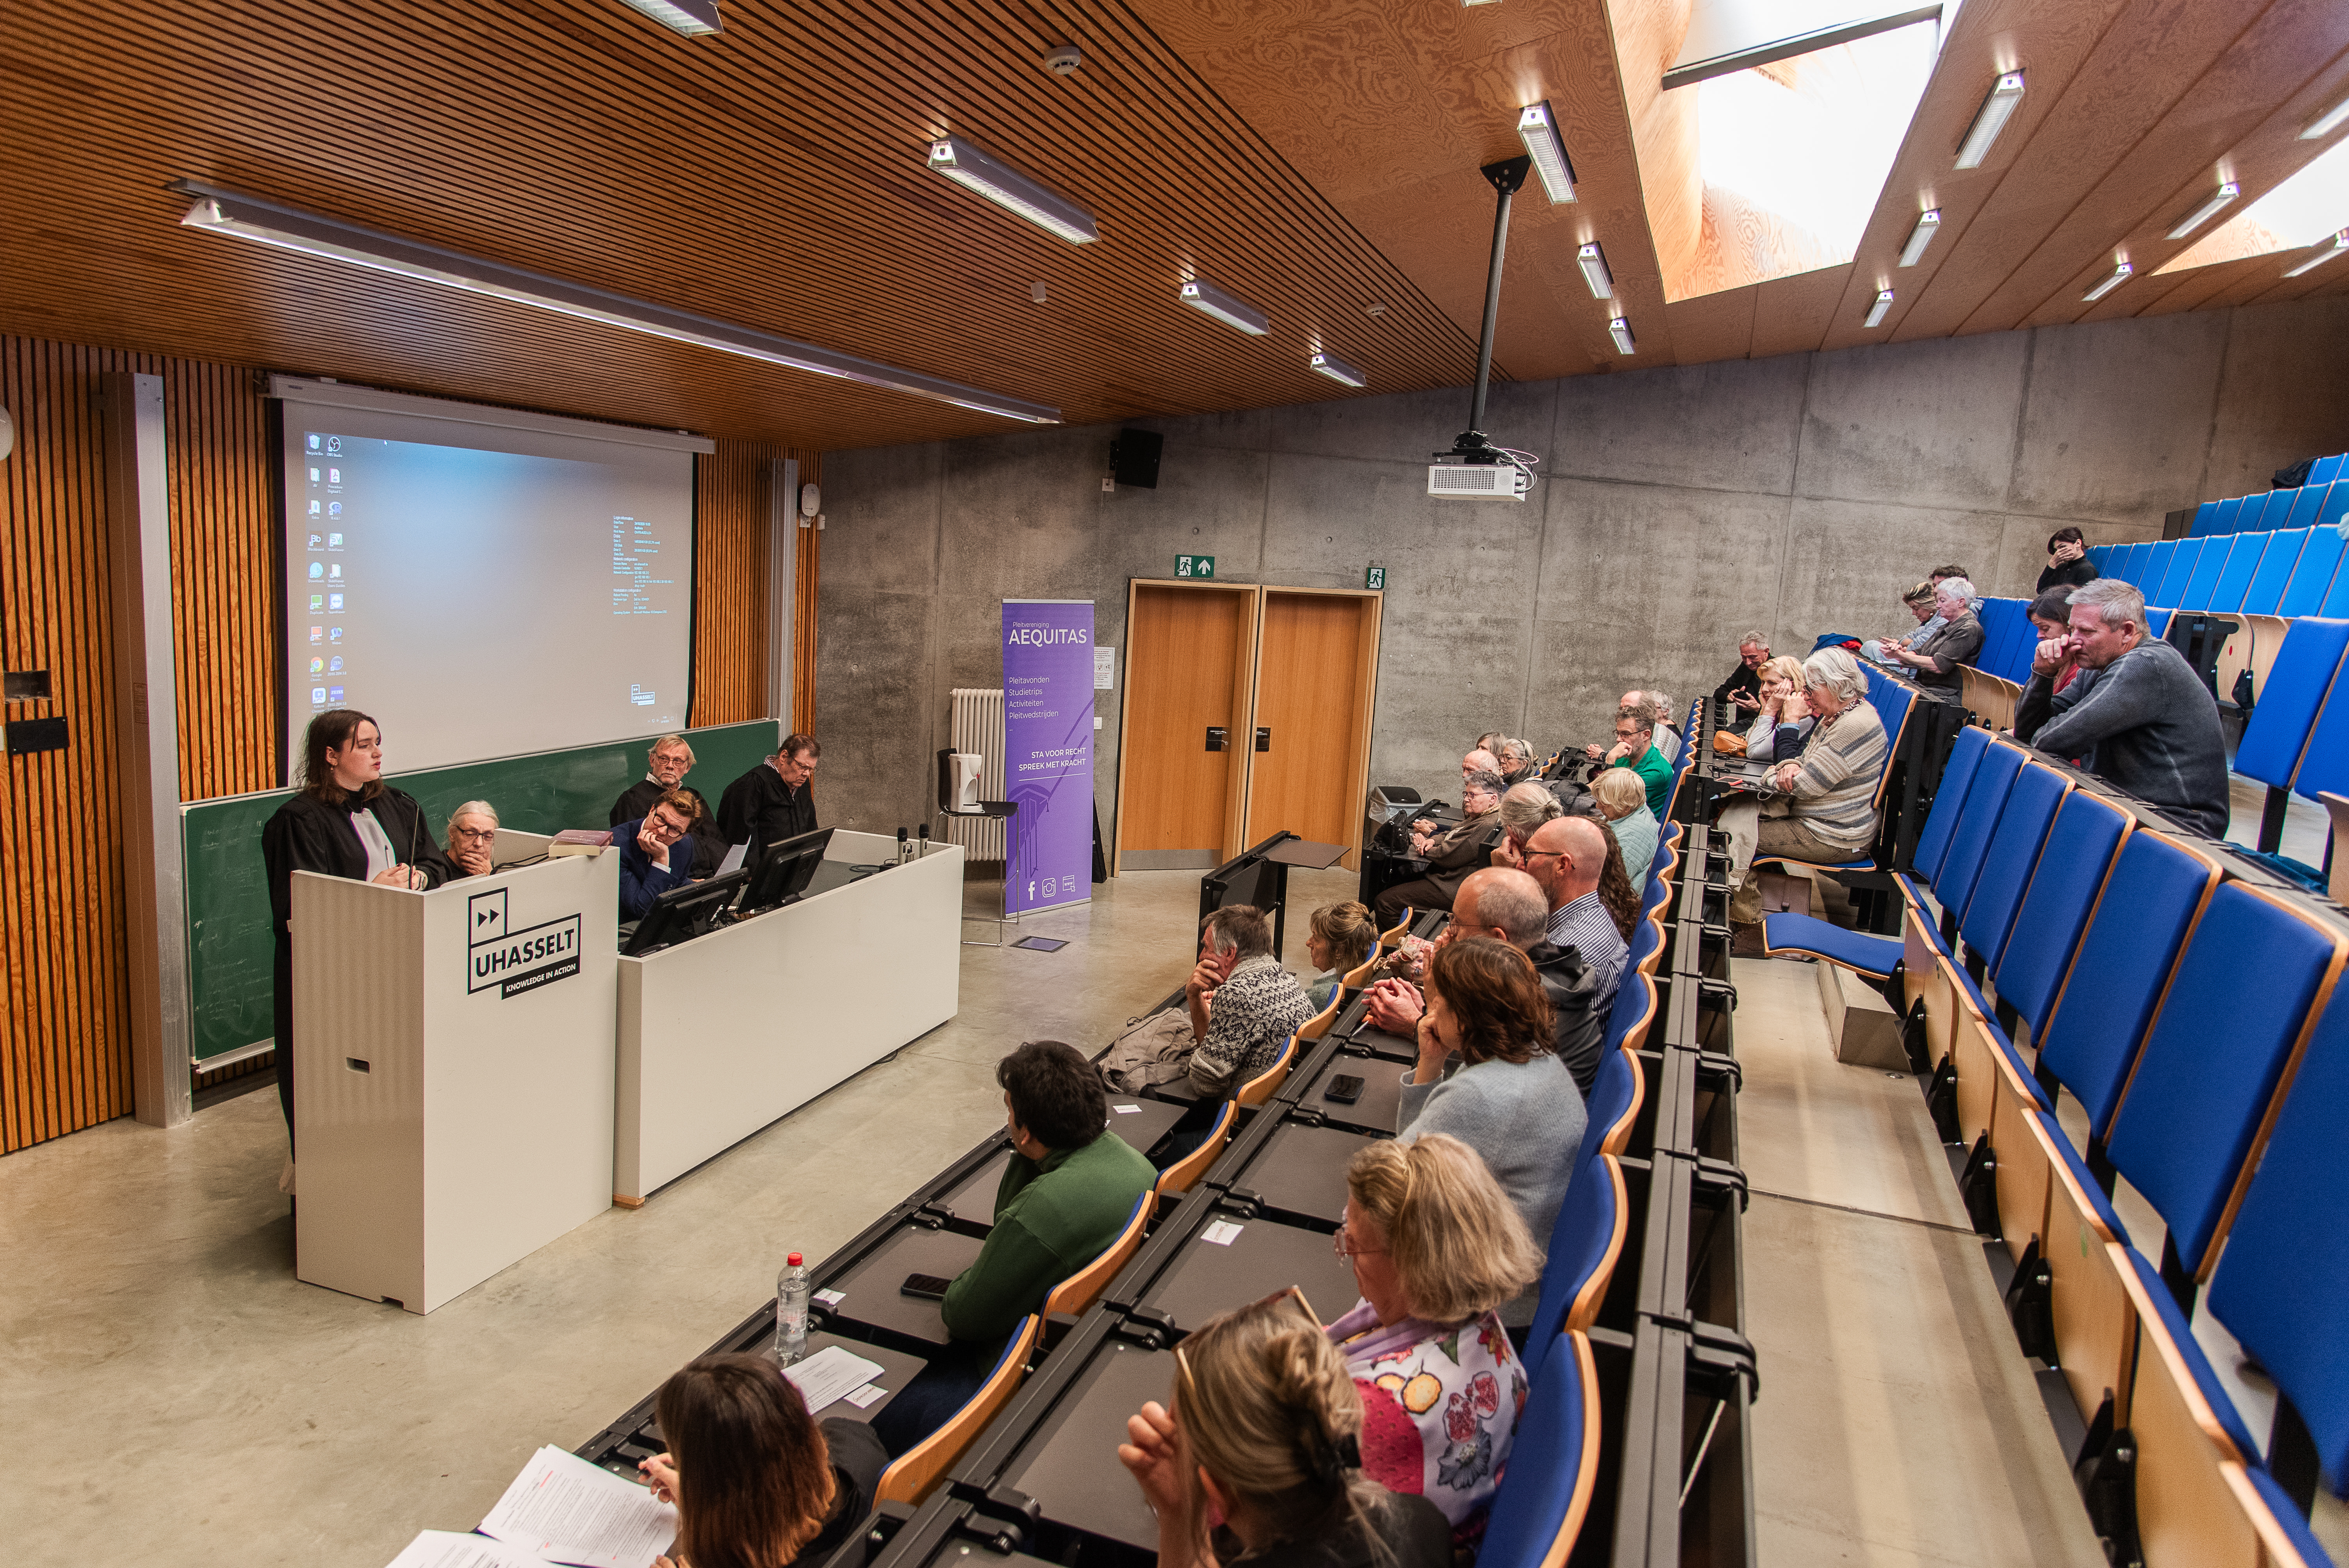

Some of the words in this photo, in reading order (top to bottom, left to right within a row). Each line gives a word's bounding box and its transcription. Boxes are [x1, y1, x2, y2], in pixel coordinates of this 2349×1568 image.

[311, 534, 321, 543] Bb
[1009, 629, 1087, 647] AEQUITAS
[1009, 676, 1050, 684] Pleitavonden
[1009, 688, 1043, 696] Studietrips
[1009, 699, 1044, 708] Activiteiten
[1009, 710, 1059, 719] Pleitwedstrijden
[1065, 747, 1086, 755] RECHT
[1019, 762, 1045, 771] SPREEK
[1061, 759, 1086, 767] KRACHT
[476, 928, 575, 977] UHASSELT
[506, 974, 545, 992] KNOWLEDGE
[554, 963, 576, 977] ACTION
